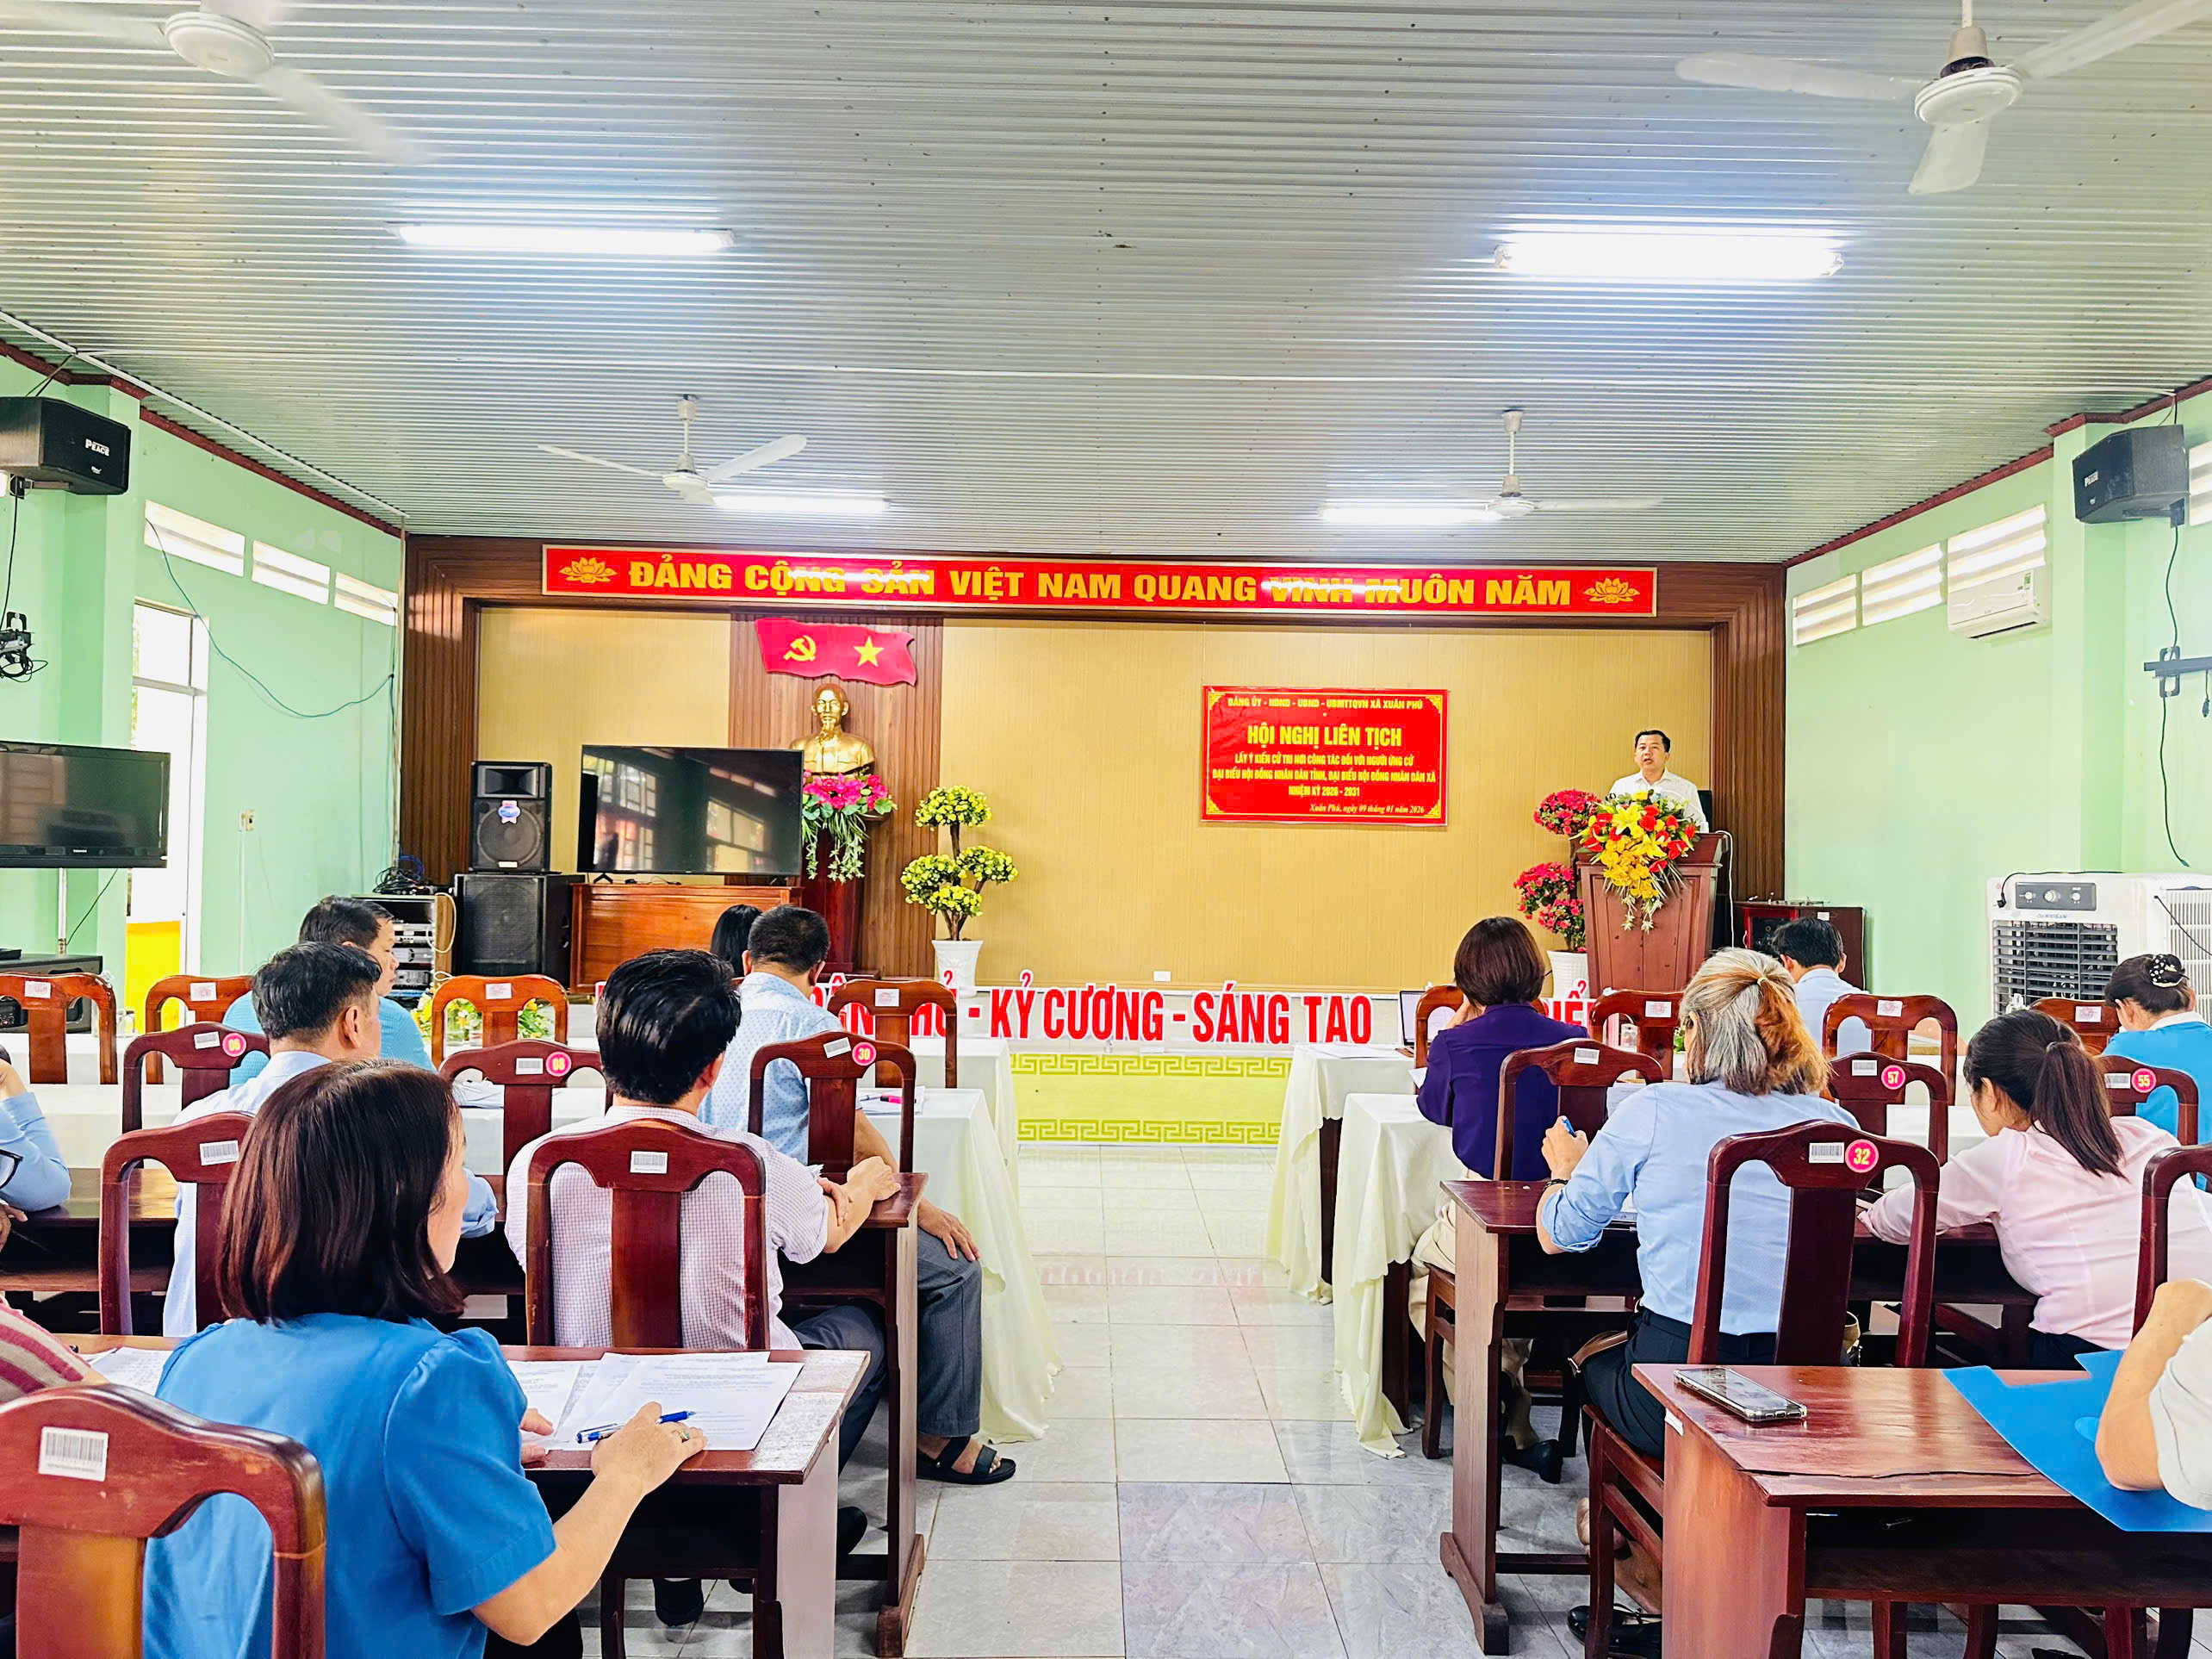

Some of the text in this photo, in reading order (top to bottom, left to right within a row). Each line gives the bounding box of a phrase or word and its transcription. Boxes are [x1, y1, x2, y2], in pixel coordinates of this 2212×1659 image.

[629, 554, 1571, 606] ĐẢNG CỘNG SẢN VIỆT NAM QUANG VINH MUÔN NĂM
[1247, 722, 1402, 750] HỘI NGHỊ LIÊN TỊCH
[1344, 786, 1360, 797] 2031
[991, 972, 1035, 1039] KỶ
[1043, 985, 1164, 1041] CƯƠNG
[1192, 983, 1289, 1043] SÁNG
[858, 1047, 870, 1059] 30
[1887, 1071, 1899, 1084] 57
[2138, 1074, 2150, 1086] 55
[1854, 1147, 1870, 1165] 32
